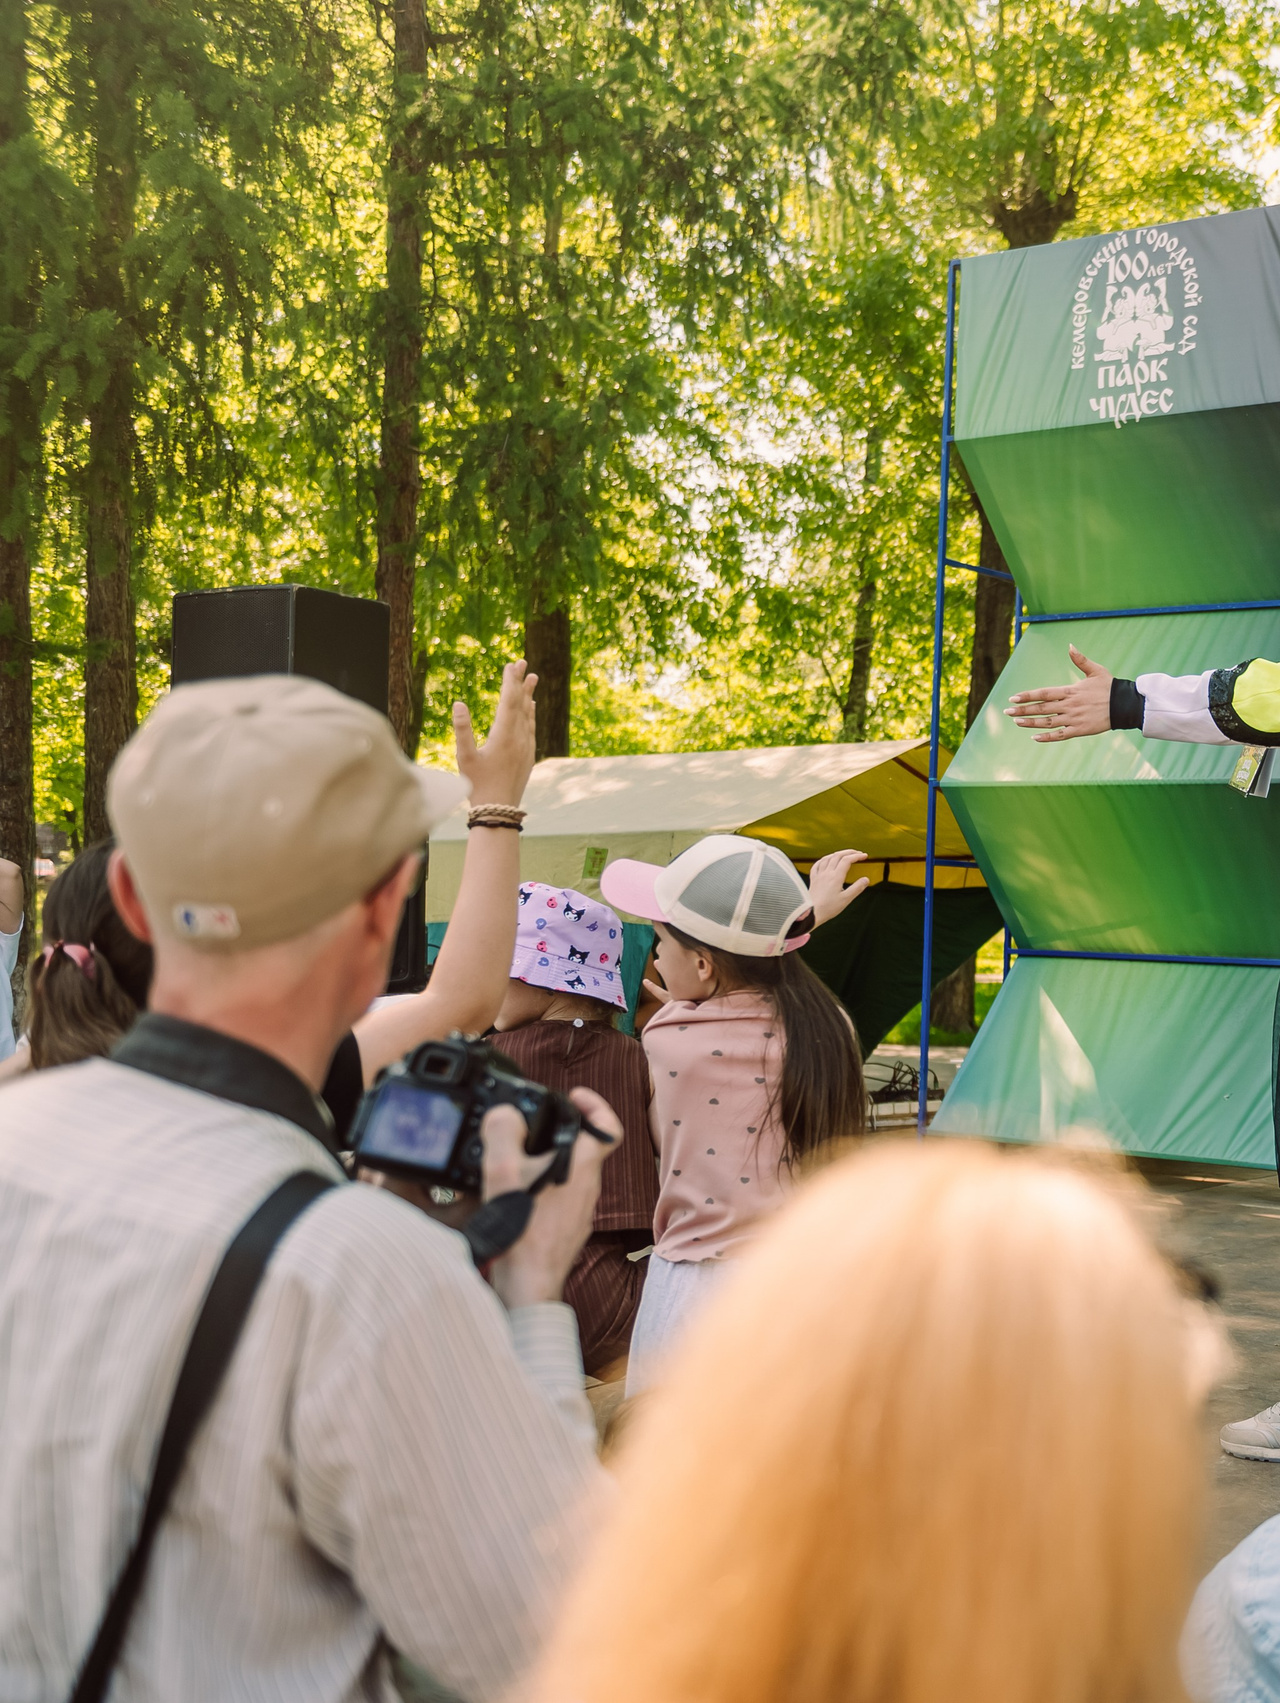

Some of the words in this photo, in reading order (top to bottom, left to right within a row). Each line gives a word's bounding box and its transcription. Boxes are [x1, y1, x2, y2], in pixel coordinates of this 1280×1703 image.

[1106, 251, 1149, 285] 100
[1147, 261, 1177, 278] ЛЕТ
[1071, 231, 1129, 370] КЕМЕРОВСКИЙ
[1135, 228, 1202, 308] ГОРОДСКОЙ
[1178, 315, 1198, 355] САД
[1097, 357, 1169, 396] ПАРК
[1088, 387, 1174, 429] ЧУДЕС
